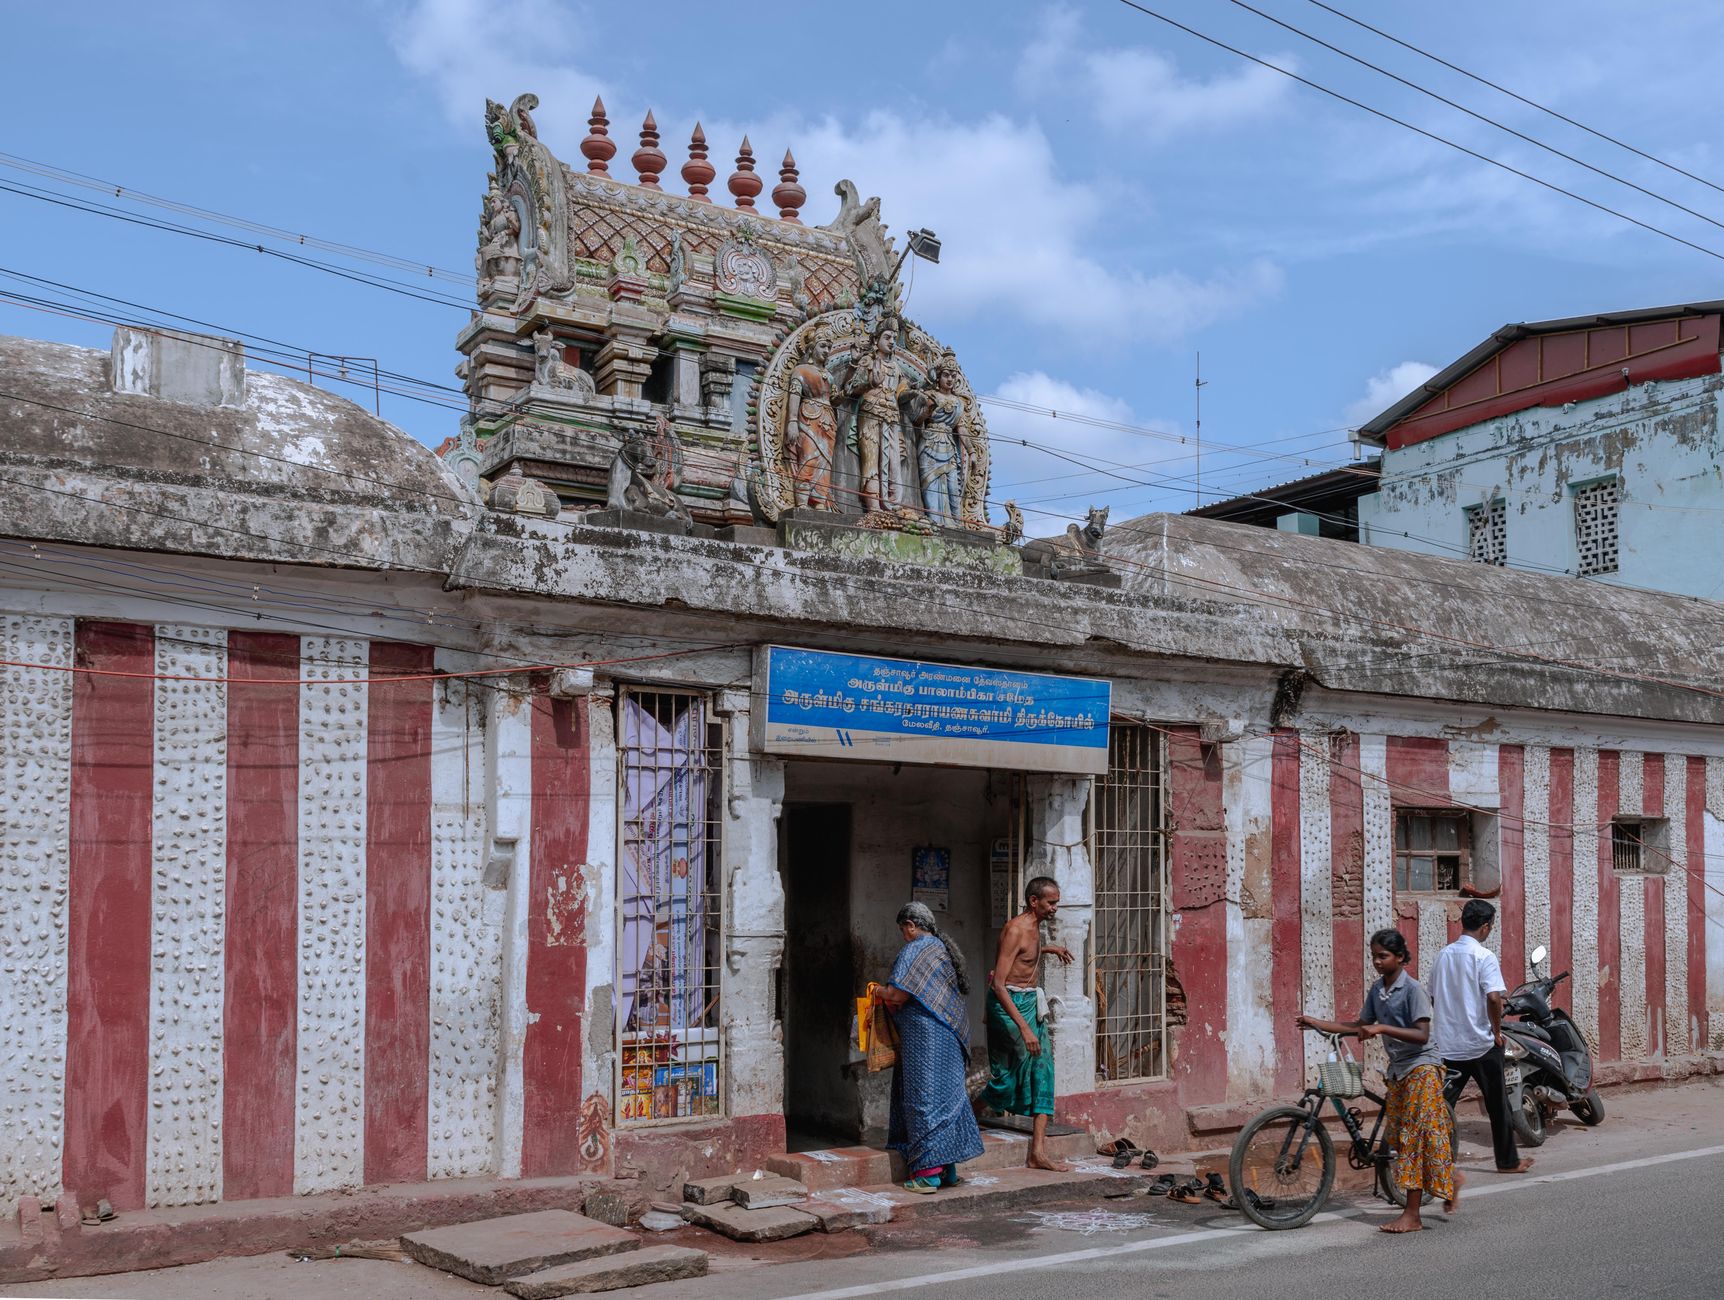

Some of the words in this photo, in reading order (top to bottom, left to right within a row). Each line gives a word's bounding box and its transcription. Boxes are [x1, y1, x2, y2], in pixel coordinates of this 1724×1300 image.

[873, 667, 917, 680] தஞ்சாவூர்
[918, 670, 971, 684] அரண்மனை
[847, 676, 916, 695] அருள்மிகு
[918, 684, 993, 701] பாலாம்பிகா
[997, 692, 1034, 705] சமேத
[781, 688, 857, 713] அருள்மிகு
[1014, 704, 1095, 730] திருக்கோயில்
